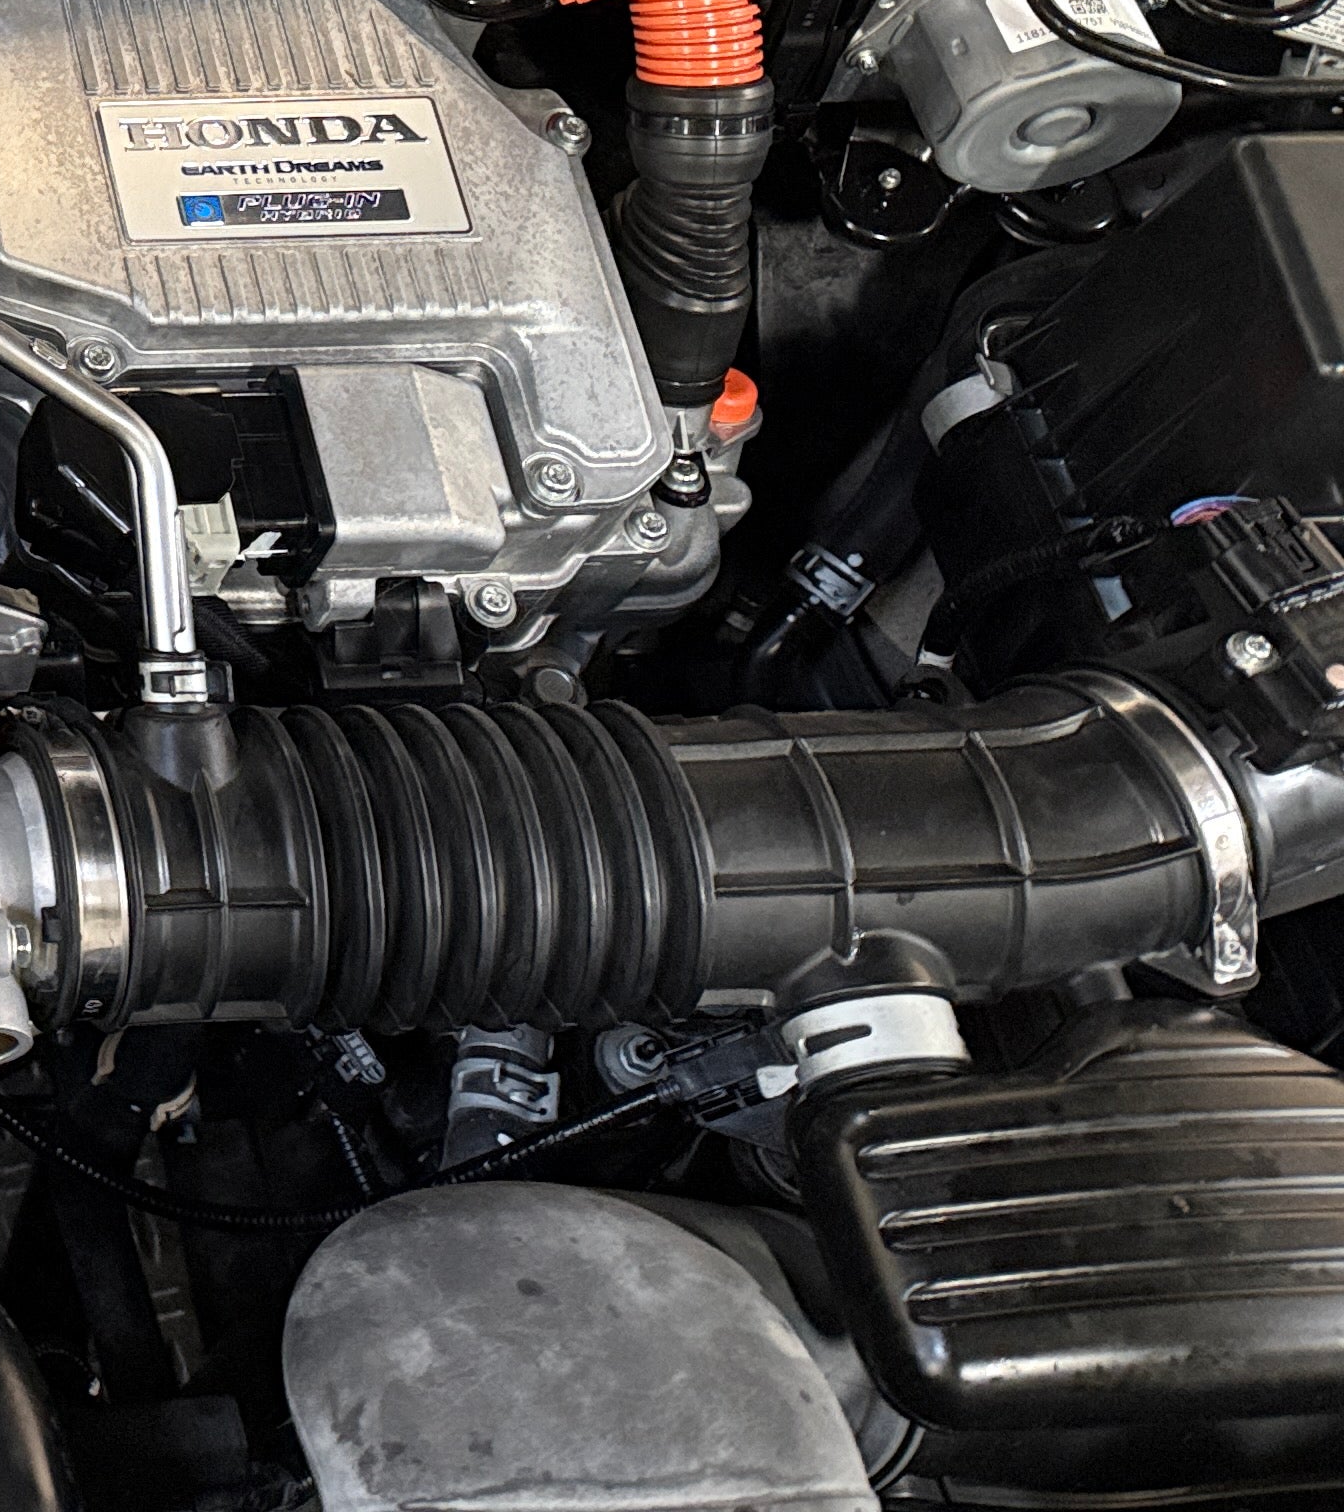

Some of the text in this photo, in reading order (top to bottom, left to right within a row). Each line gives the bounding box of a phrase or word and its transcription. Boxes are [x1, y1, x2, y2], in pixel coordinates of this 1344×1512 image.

[118, 114, 430, 152] HONDA
[181, 159, 384, 176] EARTH DREAMS
[232, 175, 338, 185] TECHNOLOGY
[237, 192, 382, 210] PLUG-IN
[260, 208, 362, 222] HYBRID
